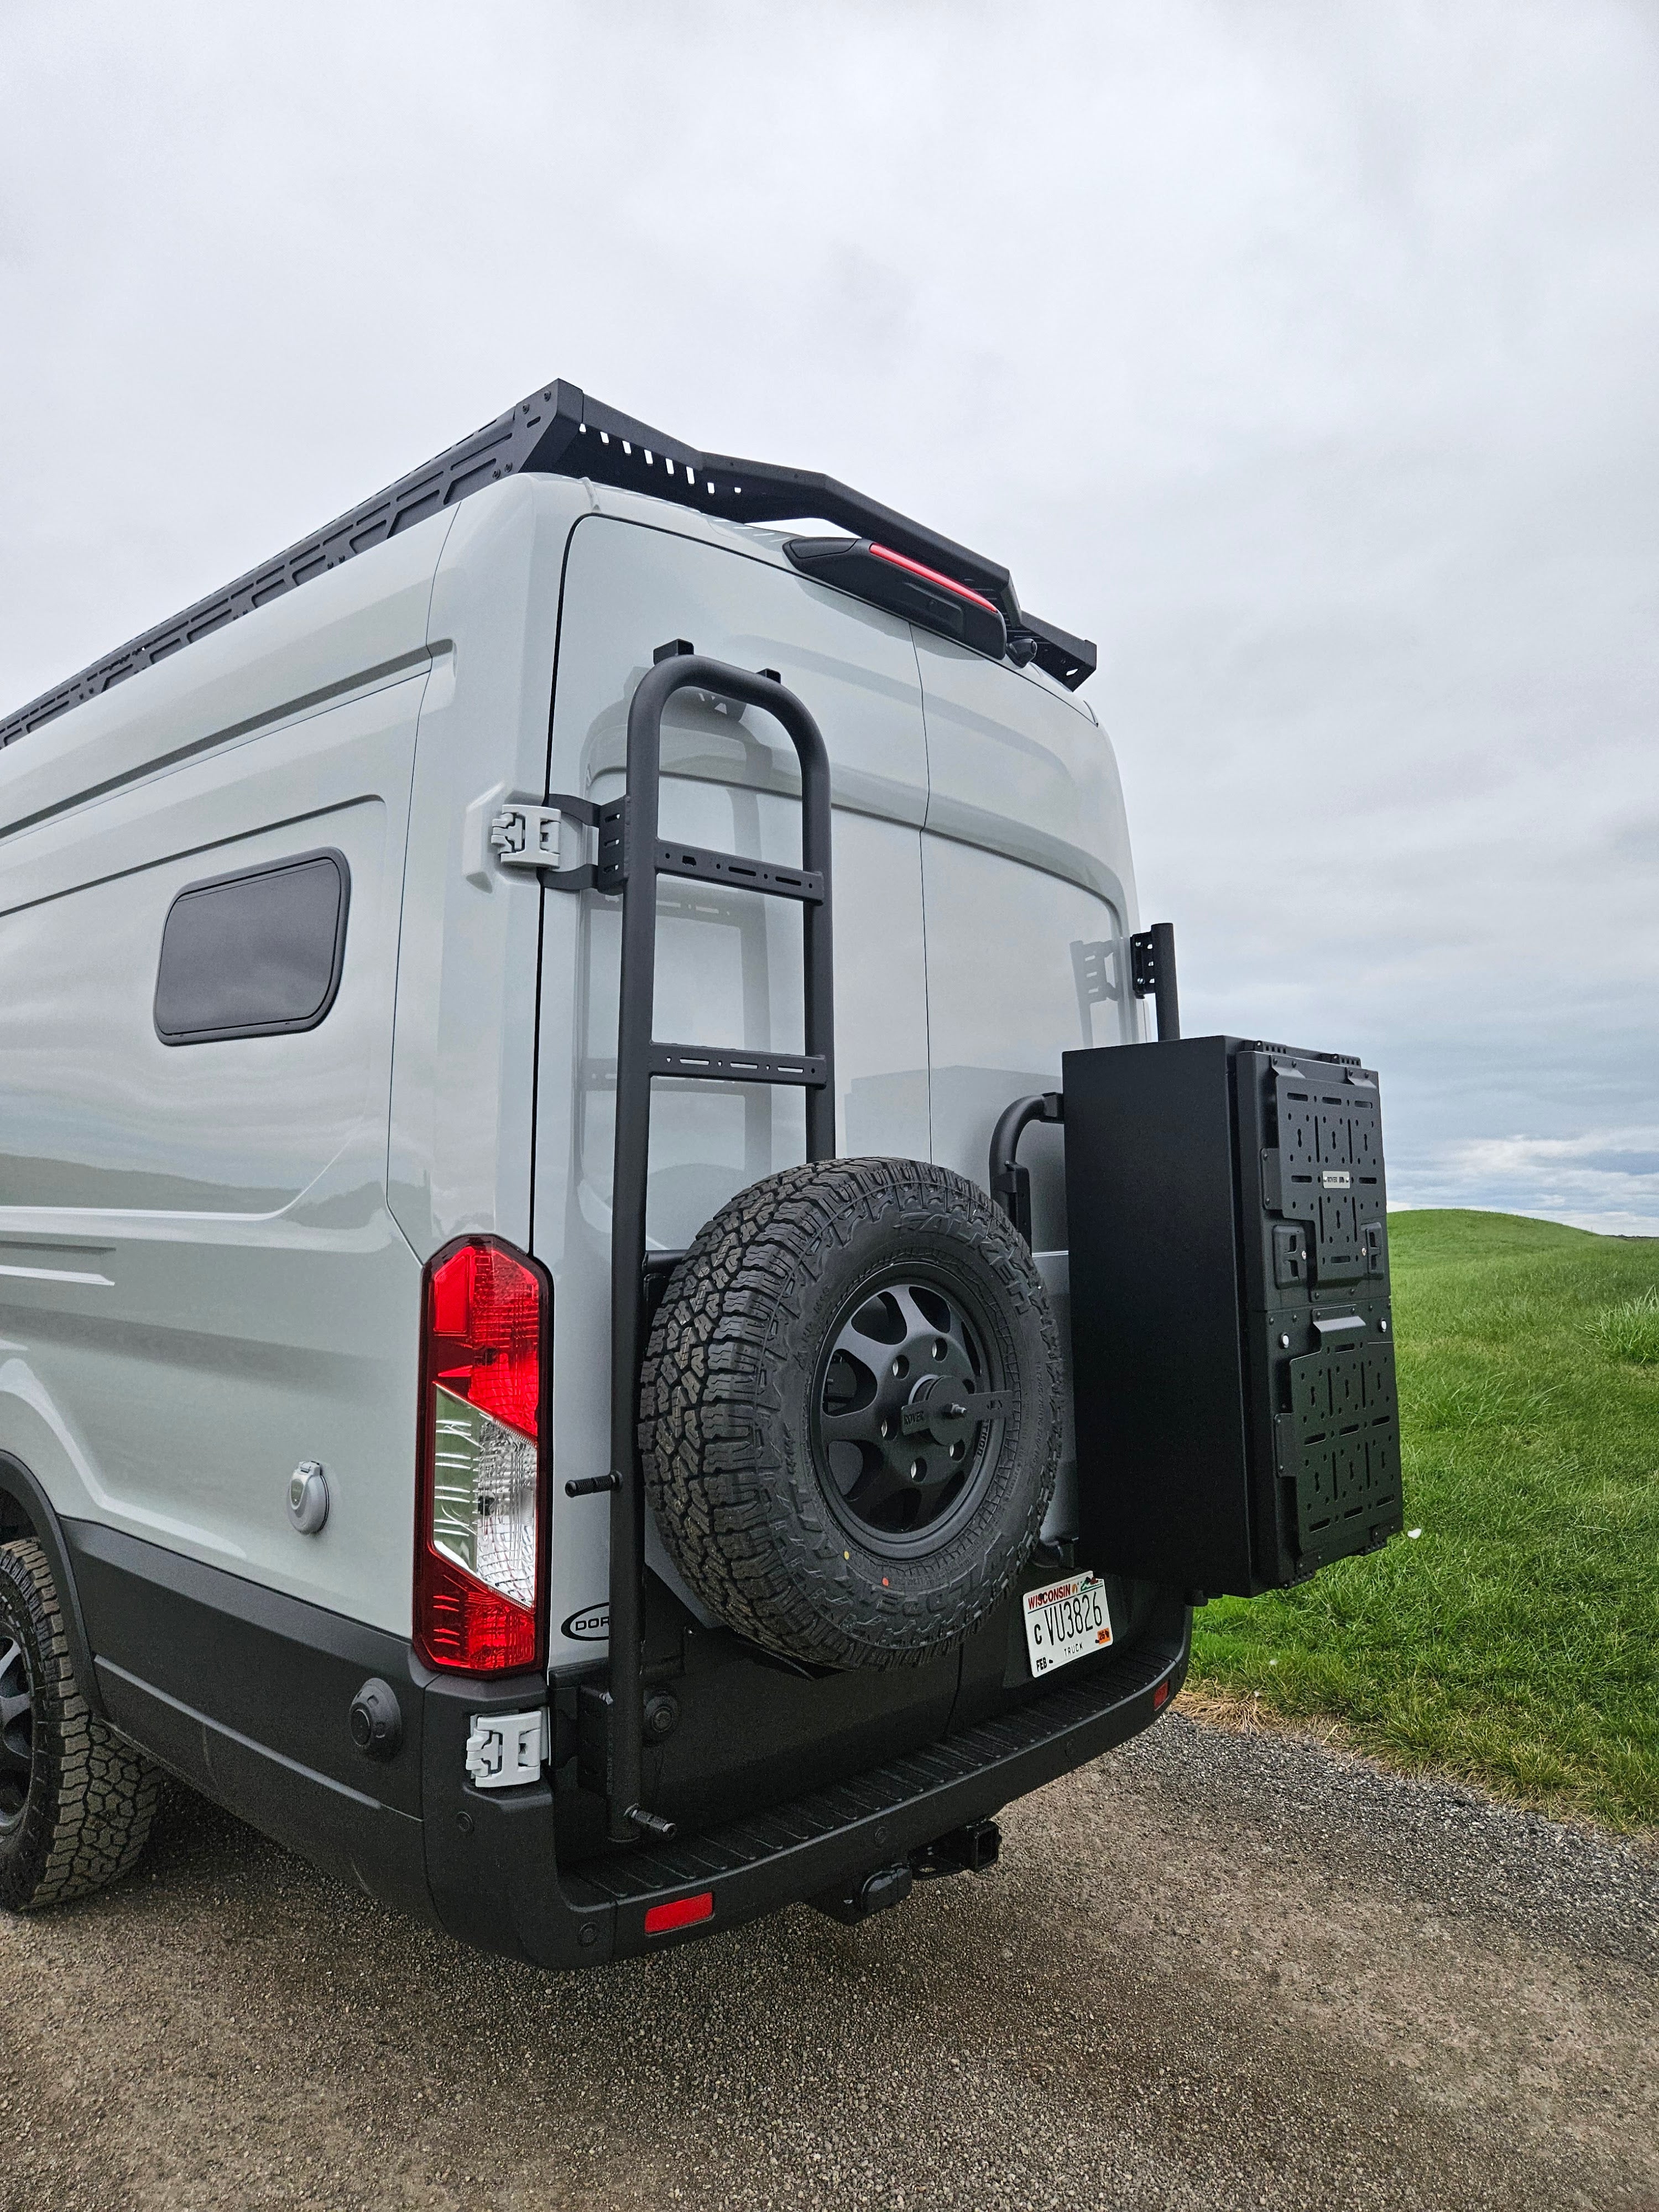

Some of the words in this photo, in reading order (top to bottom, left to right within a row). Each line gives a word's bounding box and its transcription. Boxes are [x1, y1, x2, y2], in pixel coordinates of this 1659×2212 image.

[1028, 1584, 1071, 1610] WISCONSIN
[1034, 1624, 1042, 1645] C
[1044, 1591, 1102, 1646] VU3826
[1064, 1642, 1083, 1657] TRUCK
[1036, 1657, 1047, 1672] FEB
